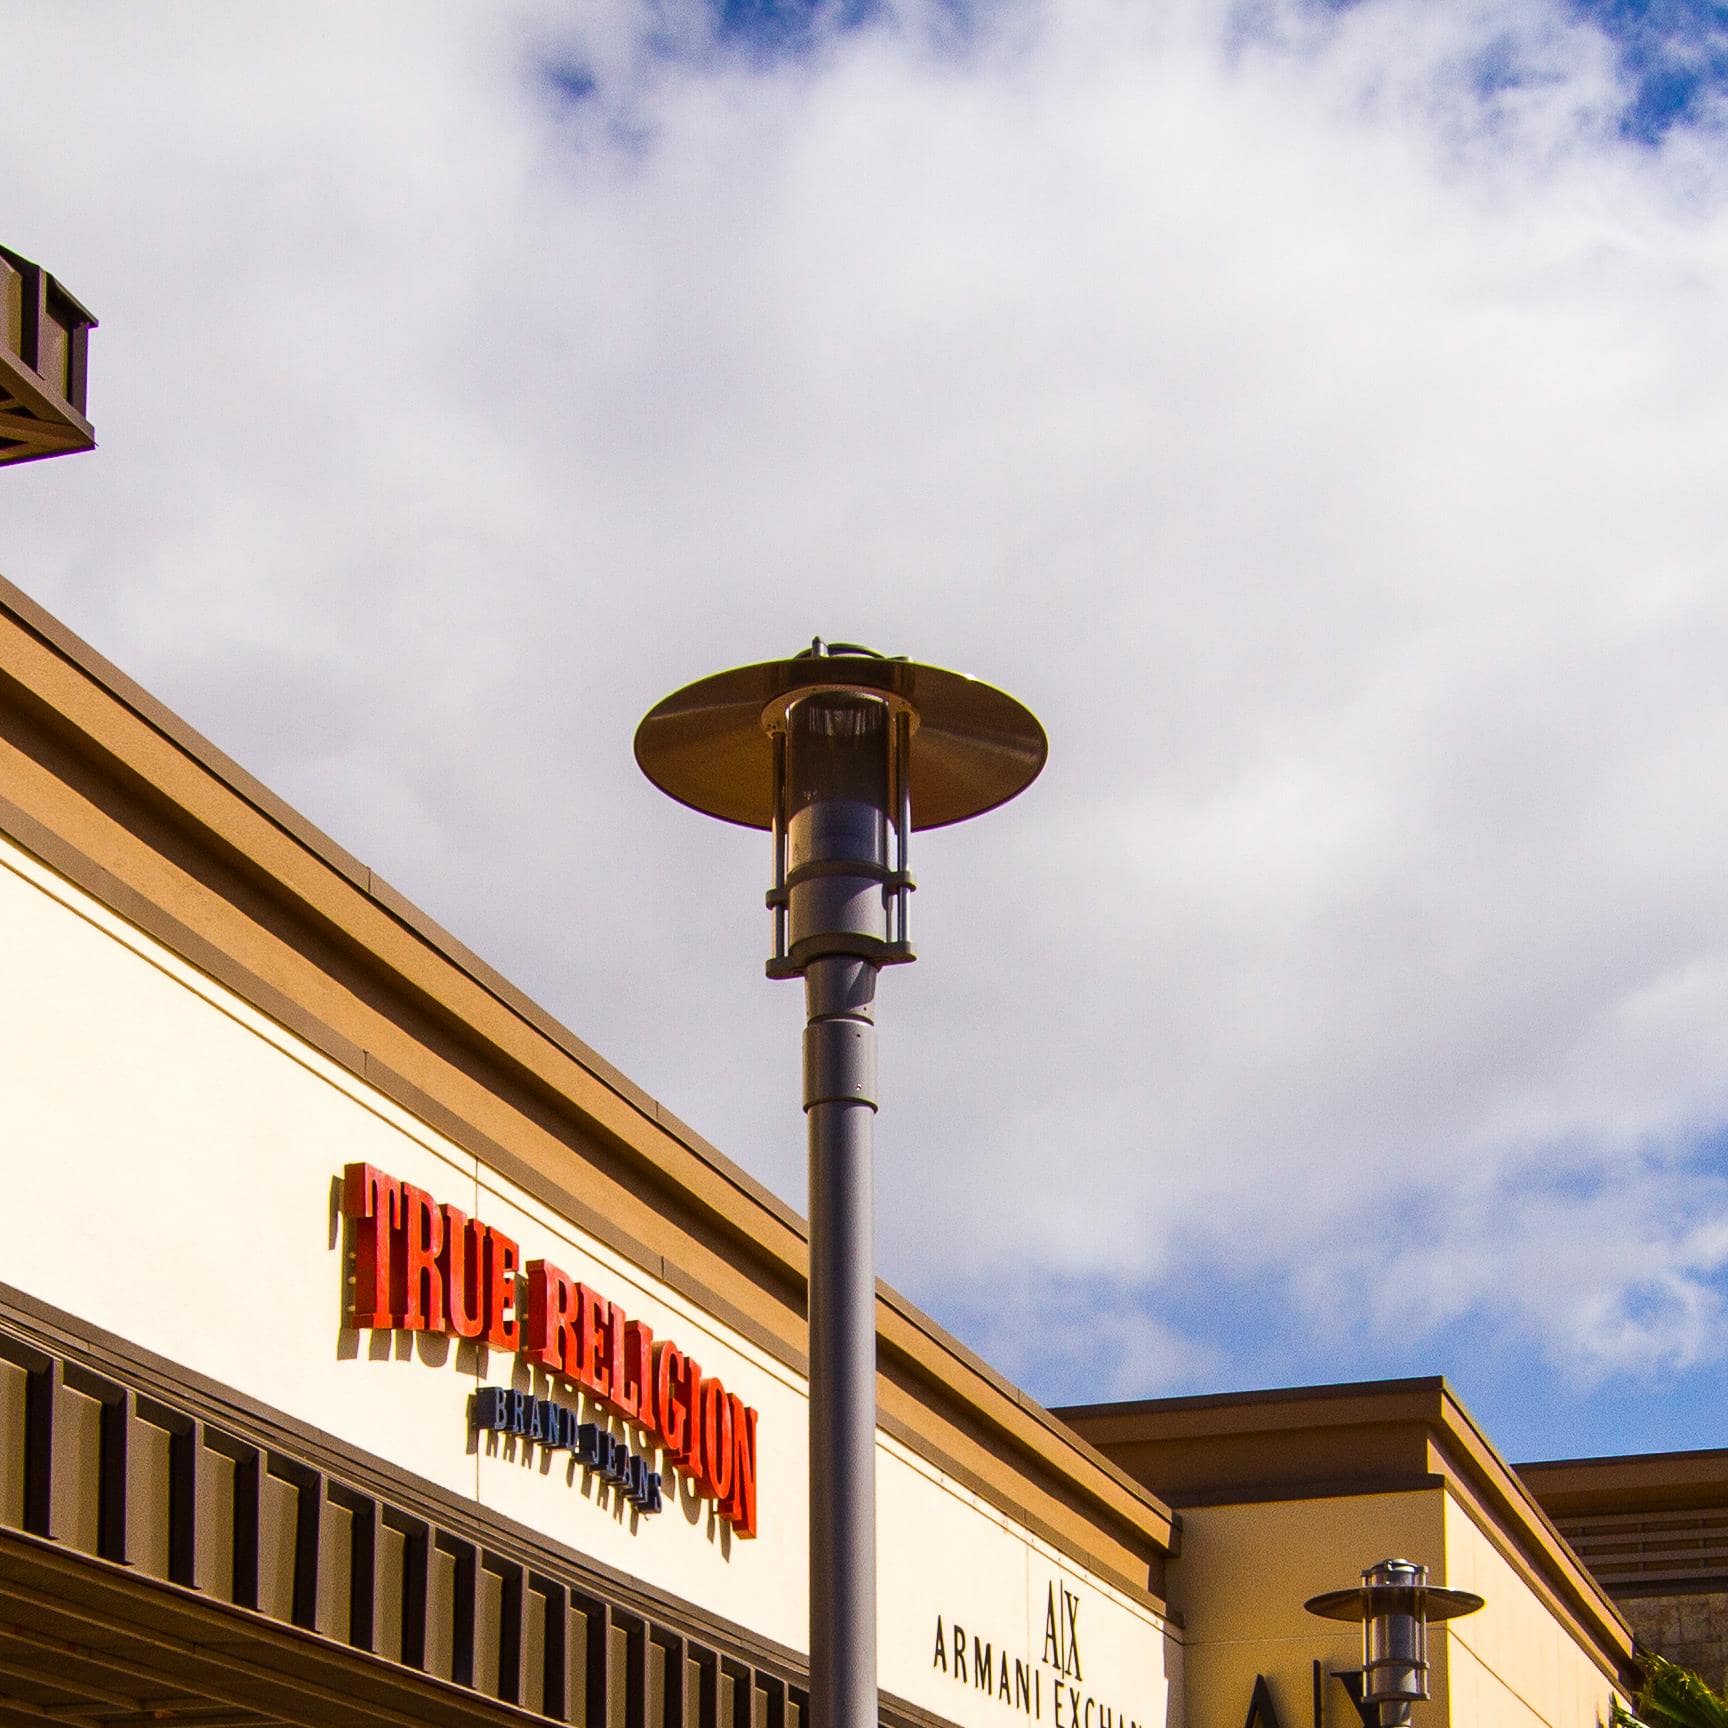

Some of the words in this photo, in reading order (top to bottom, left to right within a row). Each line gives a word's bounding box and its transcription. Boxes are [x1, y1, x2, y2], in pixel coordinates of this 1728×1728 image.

[344, 1162, 520, 1353] TRUE
[526, 1259, 759, 1540] RELIGION
[476, 1386, 579, 1452] BRAND
[933, 1614, 1041, 1720] ARMANI
